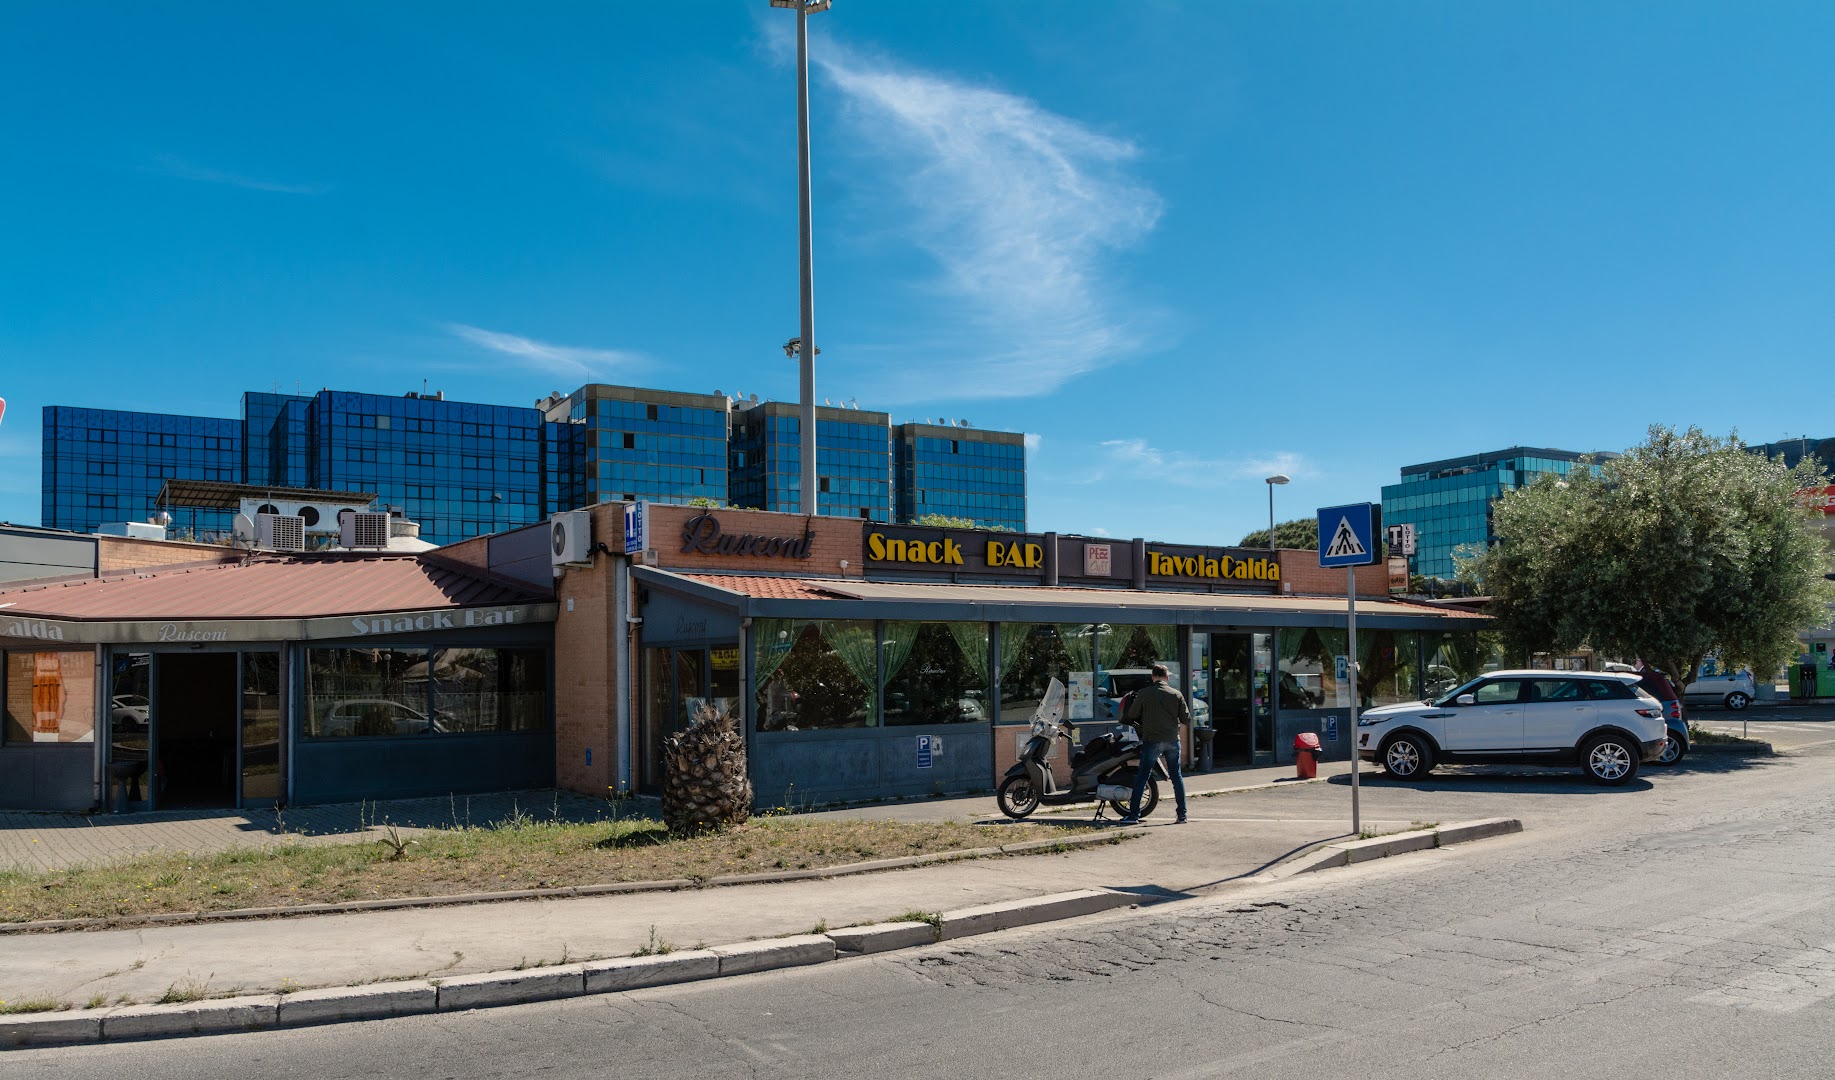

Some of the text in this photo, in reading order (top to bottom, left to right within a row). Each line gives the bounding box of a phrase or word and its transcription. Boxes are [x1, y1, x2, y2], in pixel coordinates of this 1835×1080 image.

[680, 513, 815, 559] Rusconi
[868, 533, 1043, 568] Snack BAR
[1147, 551, 1280, 581] Tavola Calda
[159, 623, 228, 641] Rusconi
[352, 609, 519, 635] Snack Bar
[1330, 718, 1335, 727] P
[920, 738, 928, 750] P
